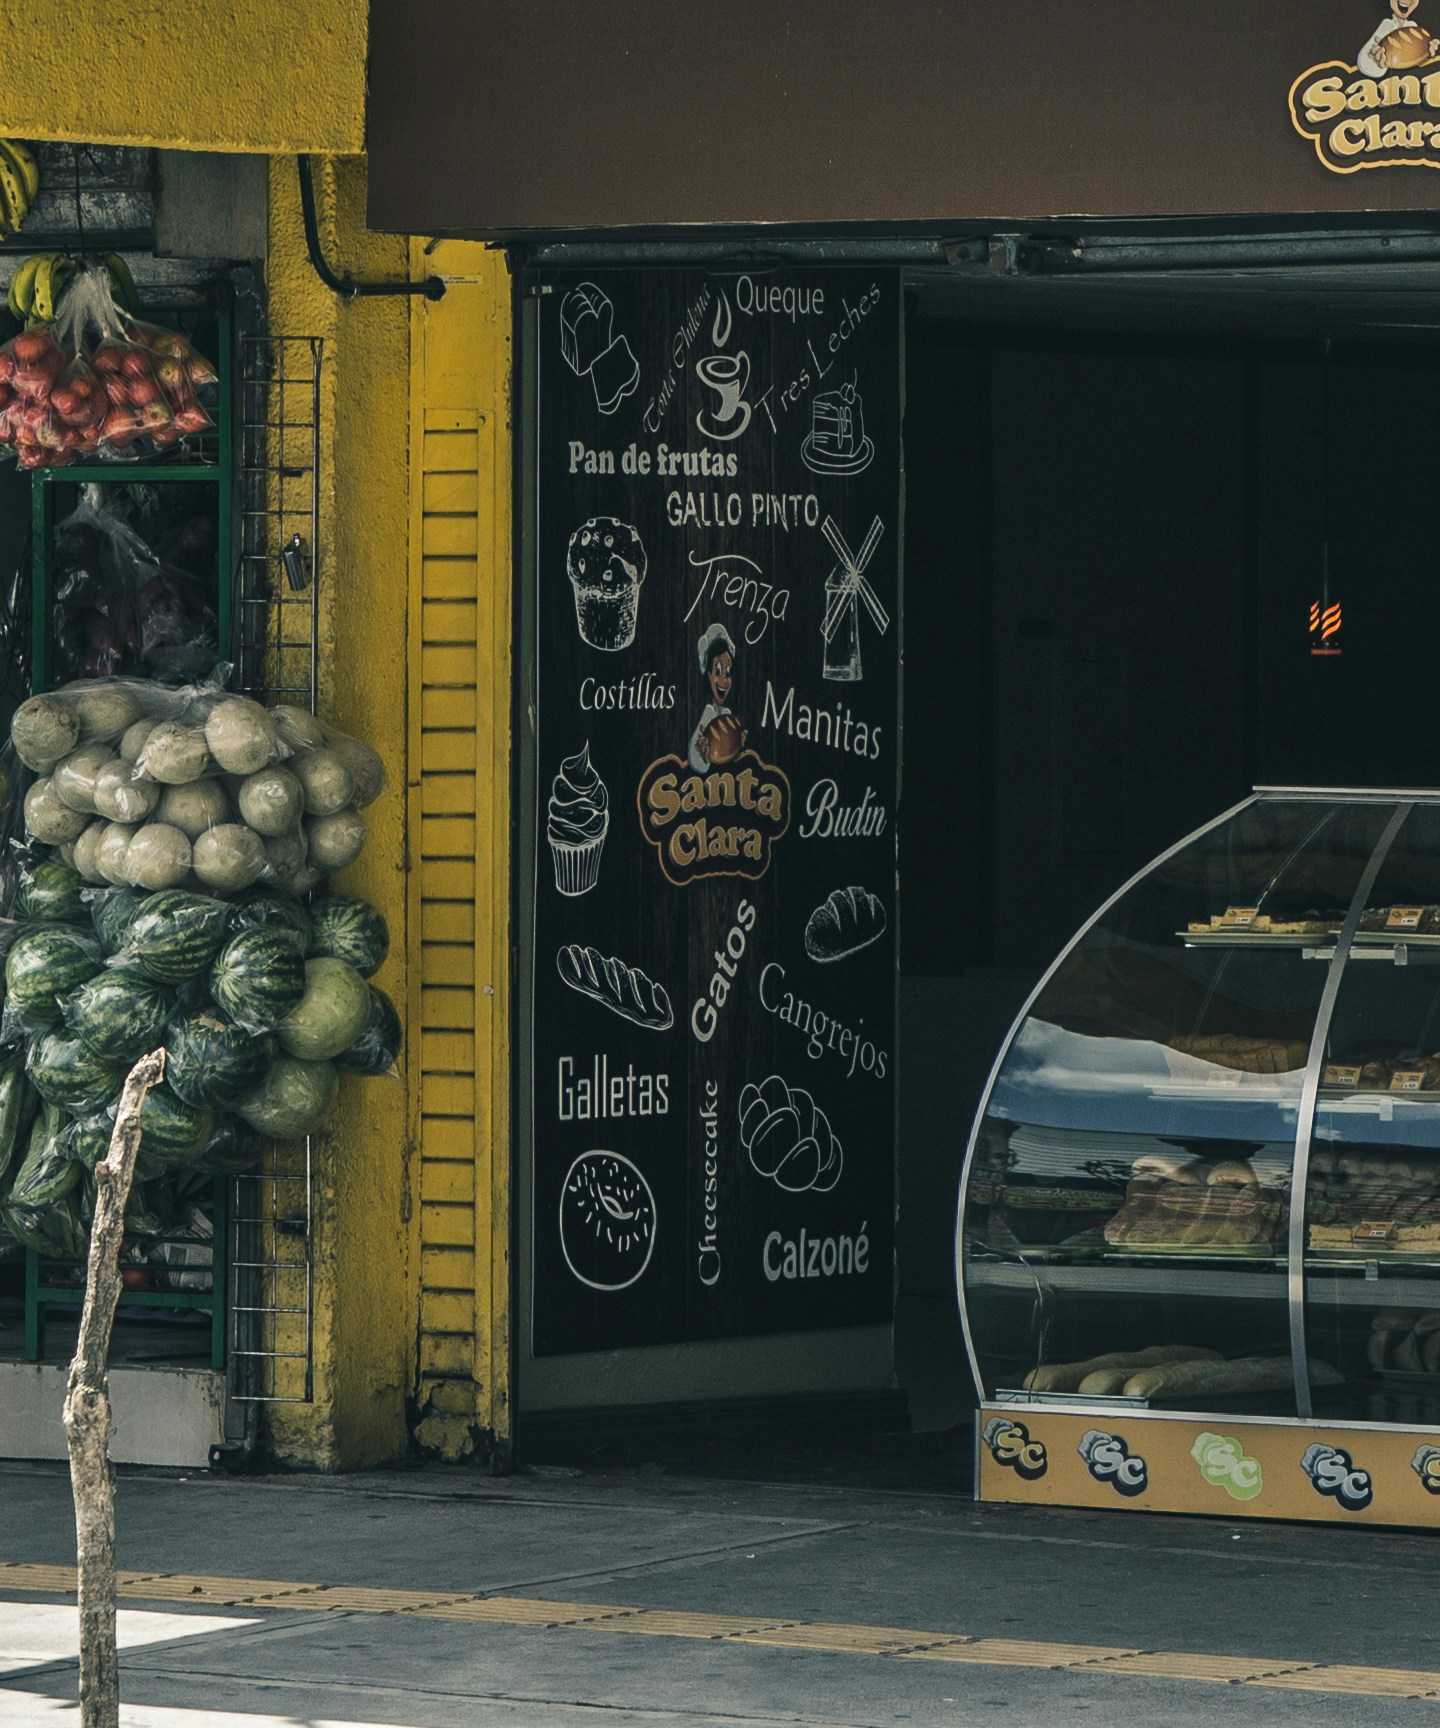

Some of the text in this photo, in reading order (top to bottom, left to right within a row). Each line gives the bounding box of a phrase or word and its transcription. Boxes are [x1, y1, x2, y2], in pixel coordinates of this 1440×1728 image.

[737, 275, 824, 323] Queque
[752, 280, 882, 434] Tres Leches
[568, 441, 738, 477] Pan de frutas
[666, 491, 819, 532] GALLO PINTO
[683, 550, 791, 645] Trenza
[579, 672, 677, 711] Costillas
[761, 680, 882, 760] Manitas
[647, 768, 783, 827] Santa
[670, 818, 763, 866] Clara
[691, 898, 757, 1042] Gatos
[759, 962, 888, 1079] Cangrejos
[559, 1054, 669, 1121] Galletas
[698, 1078, 721, 1286] Cheesecake
[763, 1220, 870, 1282] Calzoné
